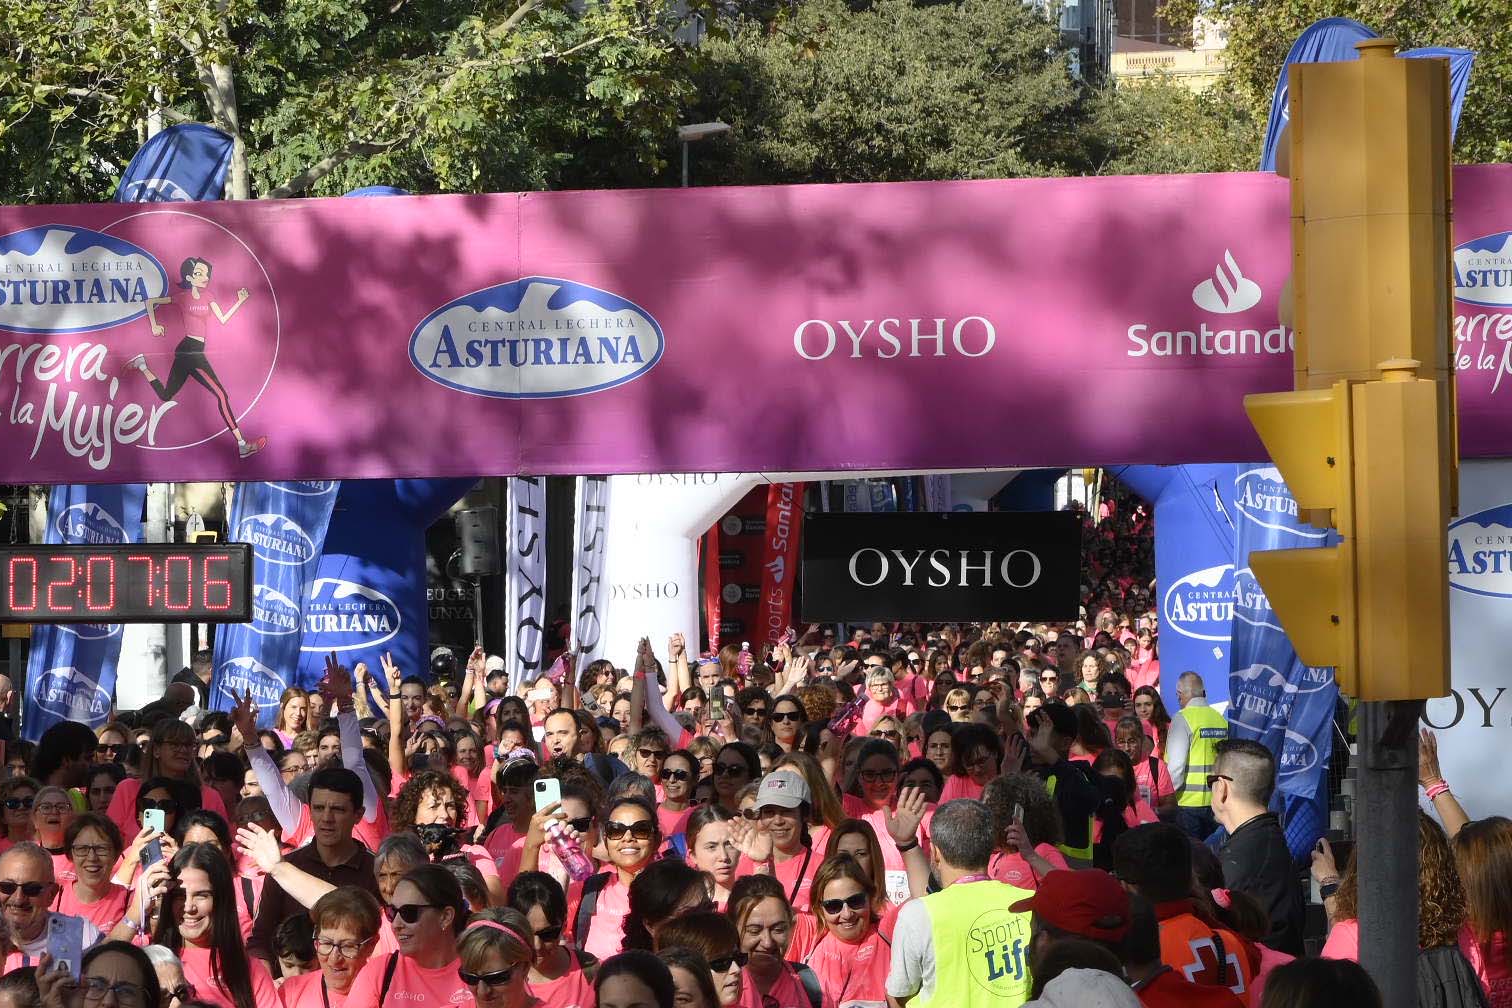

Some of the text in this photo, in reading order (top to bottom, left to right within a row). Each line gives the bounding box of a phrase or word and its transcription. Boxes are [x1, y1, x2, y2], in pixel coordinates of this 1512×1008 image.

[71, 260, 144, 272] LECHERA
[468, 317, 636, 333] CENTRAL LECHERA
[793, 316, 996, 360] OYSHO
[428, 324, 645, 368] ASTURIANA
[1478, 342, 1495, 370] la
[10, 387, 34, 425] la
[29, 376, 179, 471] Mujer
[1240, 482, 1298, 516] ASTUR
[1258, 483, 1288, 495] CENTR
[9, 556, 231, 611] 02:07:06
[849, 548, 1042, 588] OYSHO
[970, 916, 1024, 953] Sport
